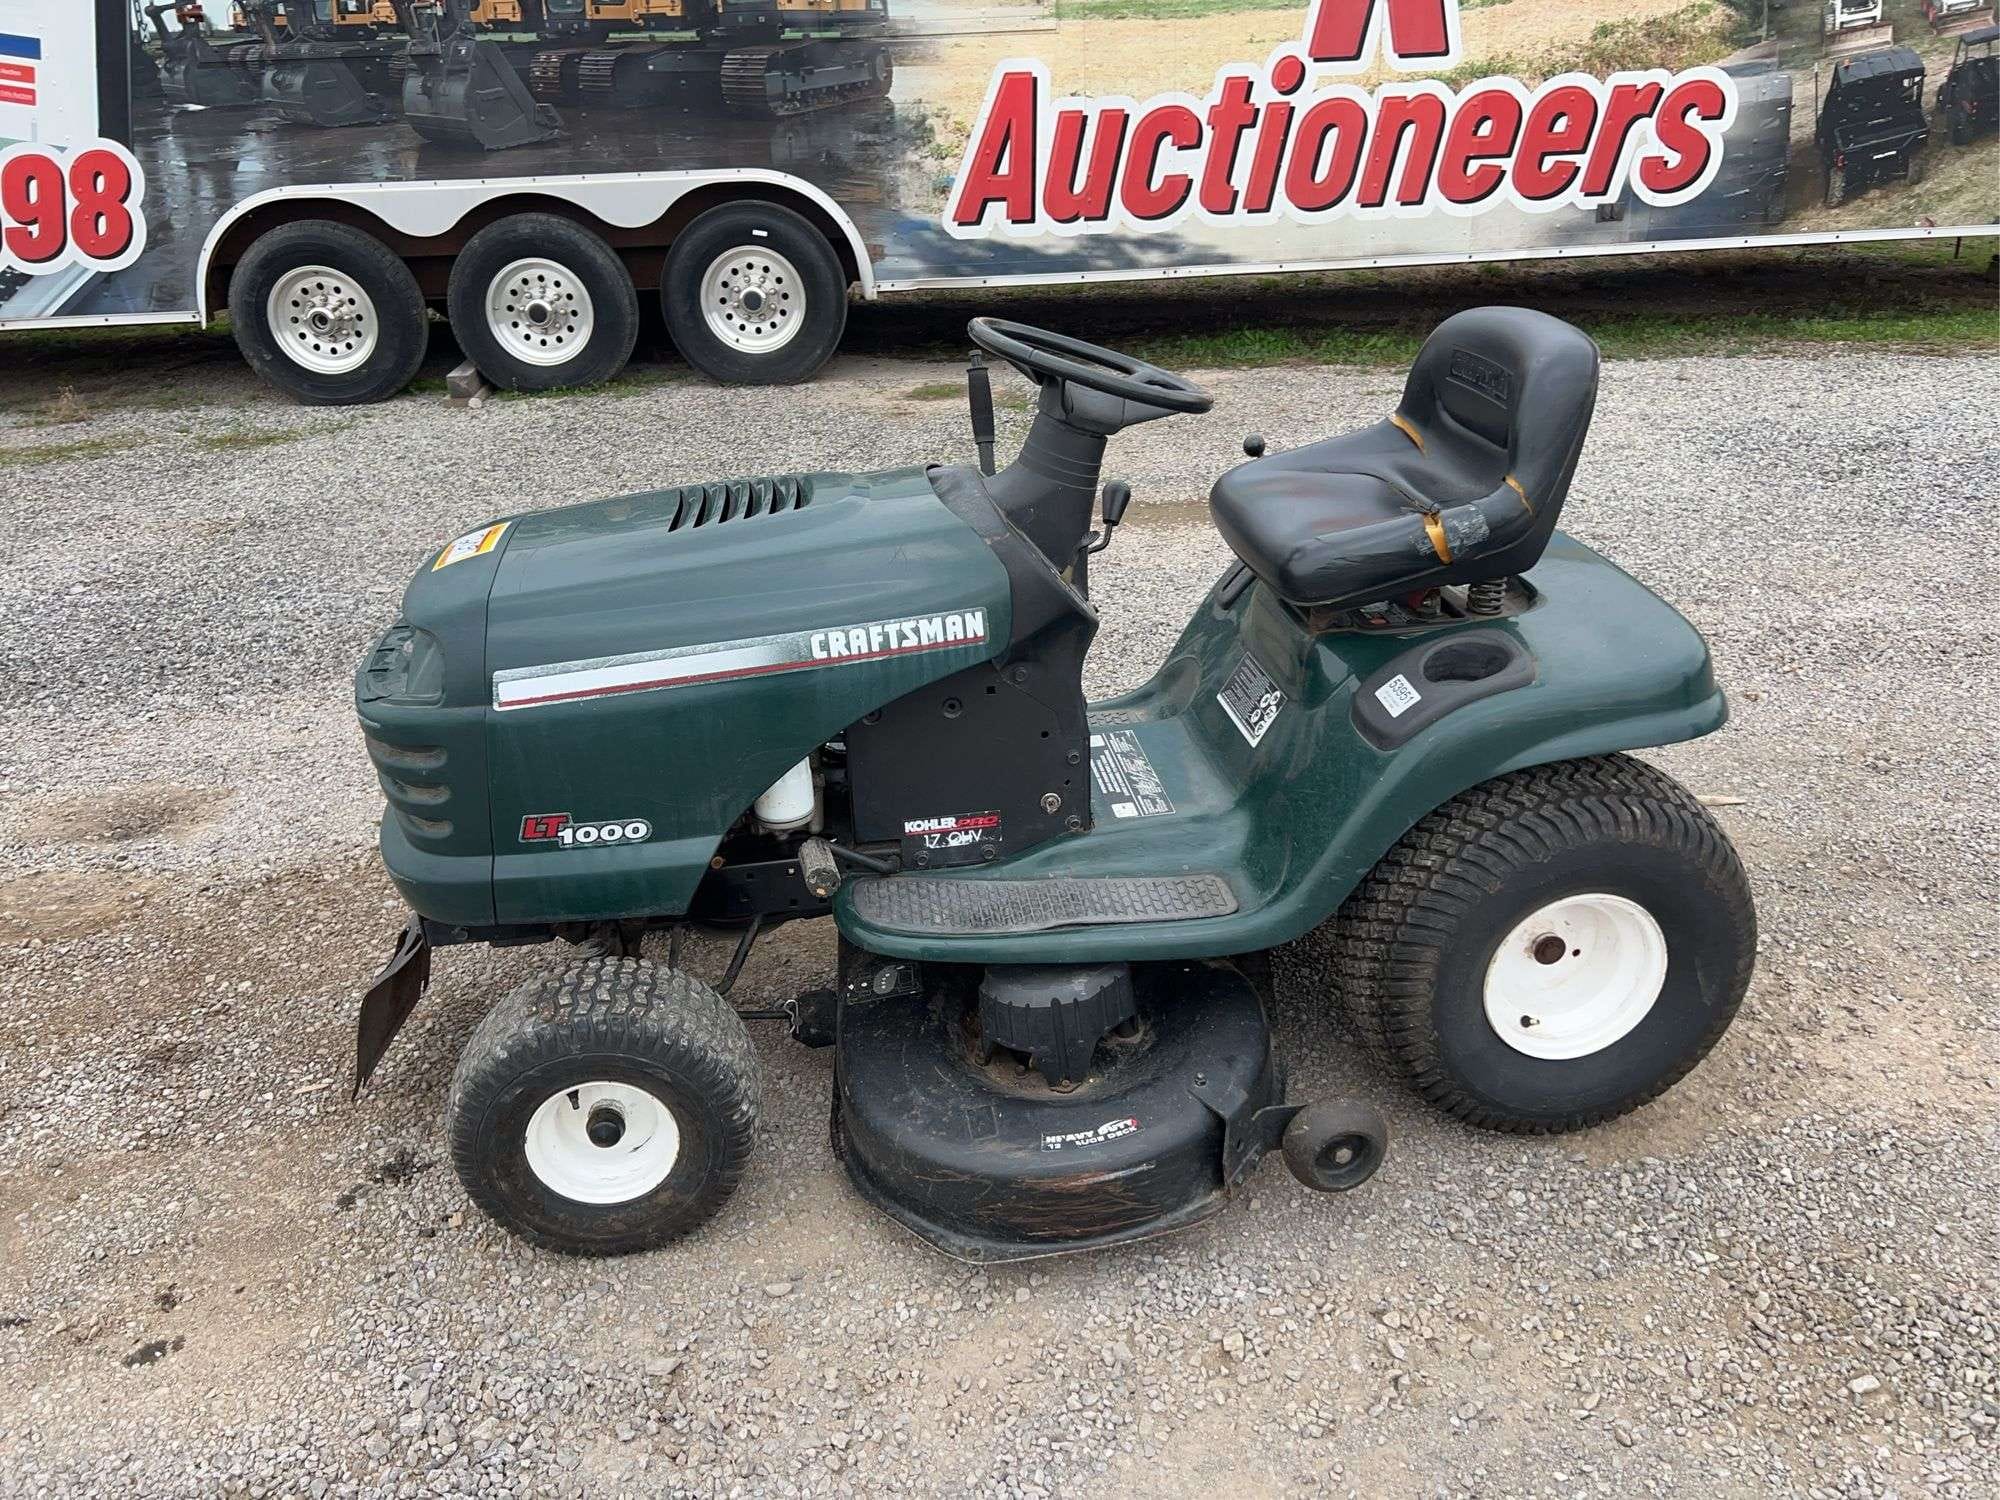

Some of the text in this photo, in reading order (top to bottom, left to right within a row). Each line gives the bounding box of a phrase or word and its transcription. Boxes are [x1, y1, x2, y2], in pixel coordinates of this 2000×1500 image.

[953, 55, 1727, 226] Auctioneers
[1, 150, 134, 264] 98
[810, 611, 985, 660] CRAFTSMAN
[1389, 678, 1415, 705] 53951
[904, 815, 998, 833] KOHLER PRO
